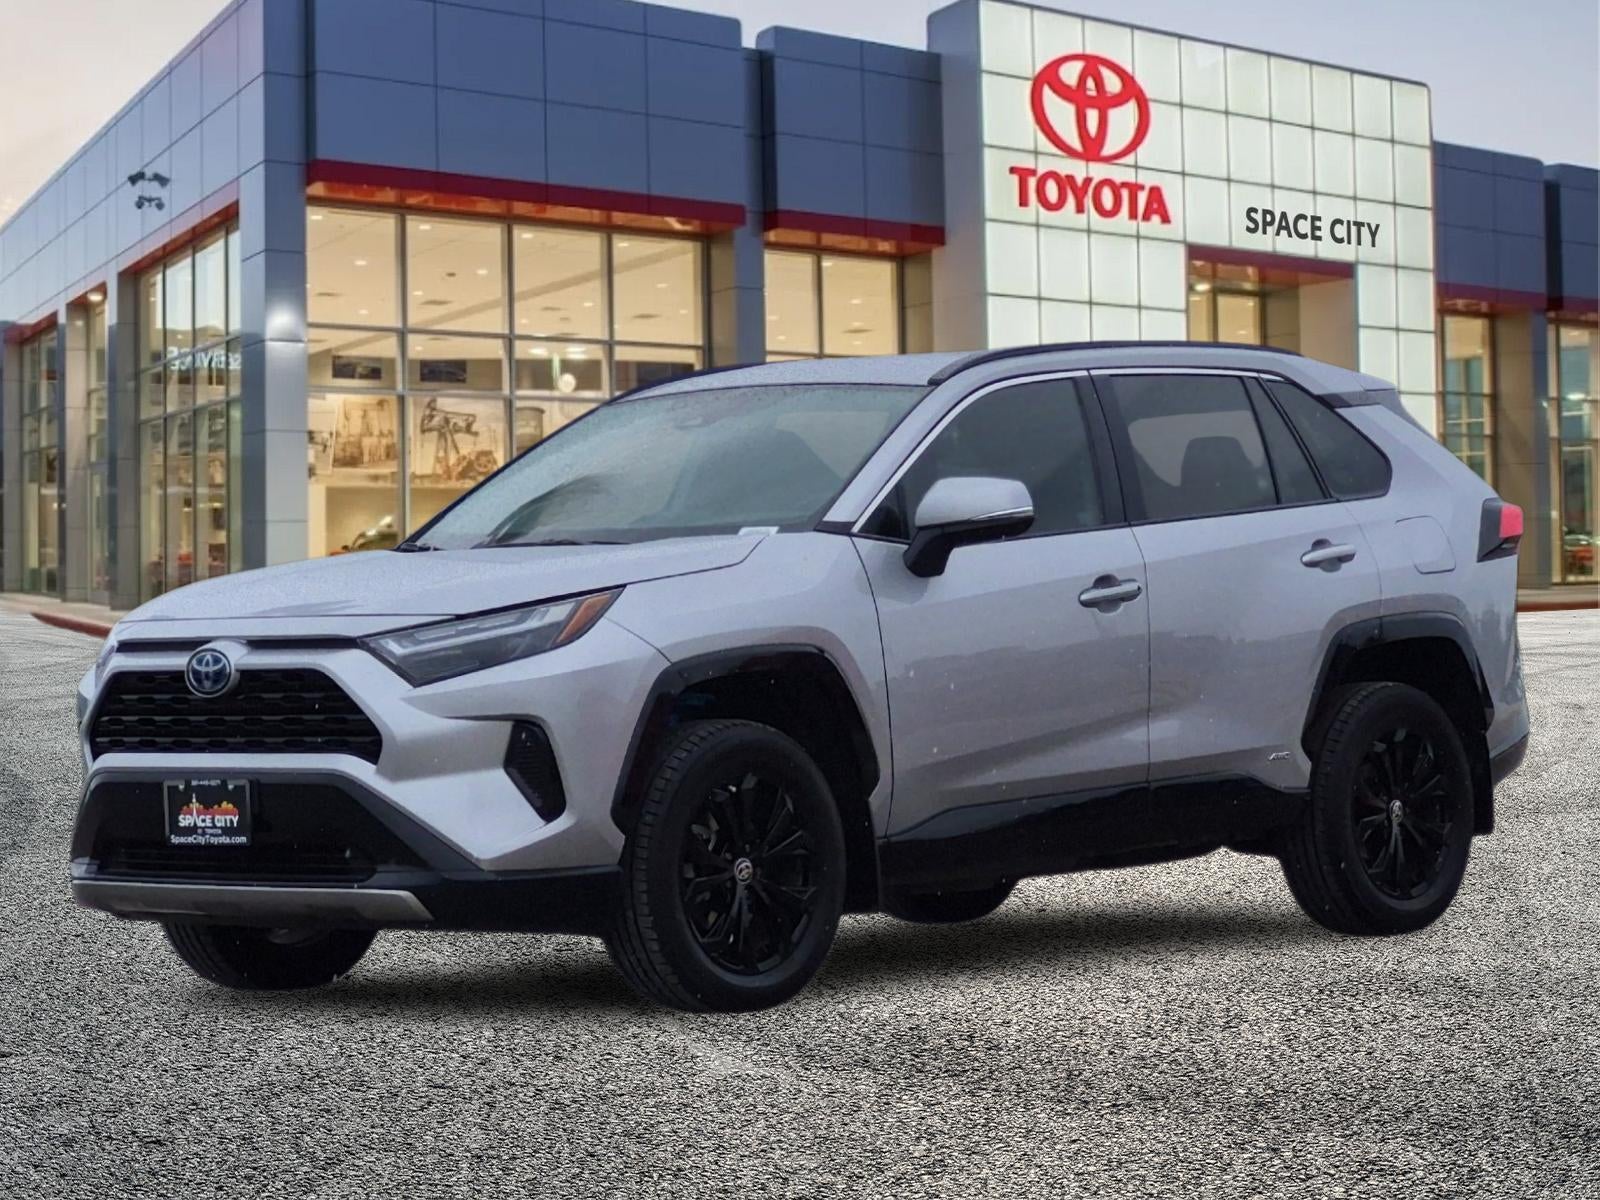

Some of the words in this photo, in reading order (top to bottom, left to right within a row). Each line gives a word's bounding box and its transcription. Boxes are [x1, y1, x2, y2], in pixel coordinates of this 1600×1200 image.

[1009, 167, 1171, 224] TOYOTA
[1245, 206, 1322, 242] SPACE
[1329, 218, 1380, 248] CITY
[178, 814, 213, 827] SPACE
[214, 815, 239, 827] CITY
[170, 834, 247, 845] SpaceCityToyota.com
